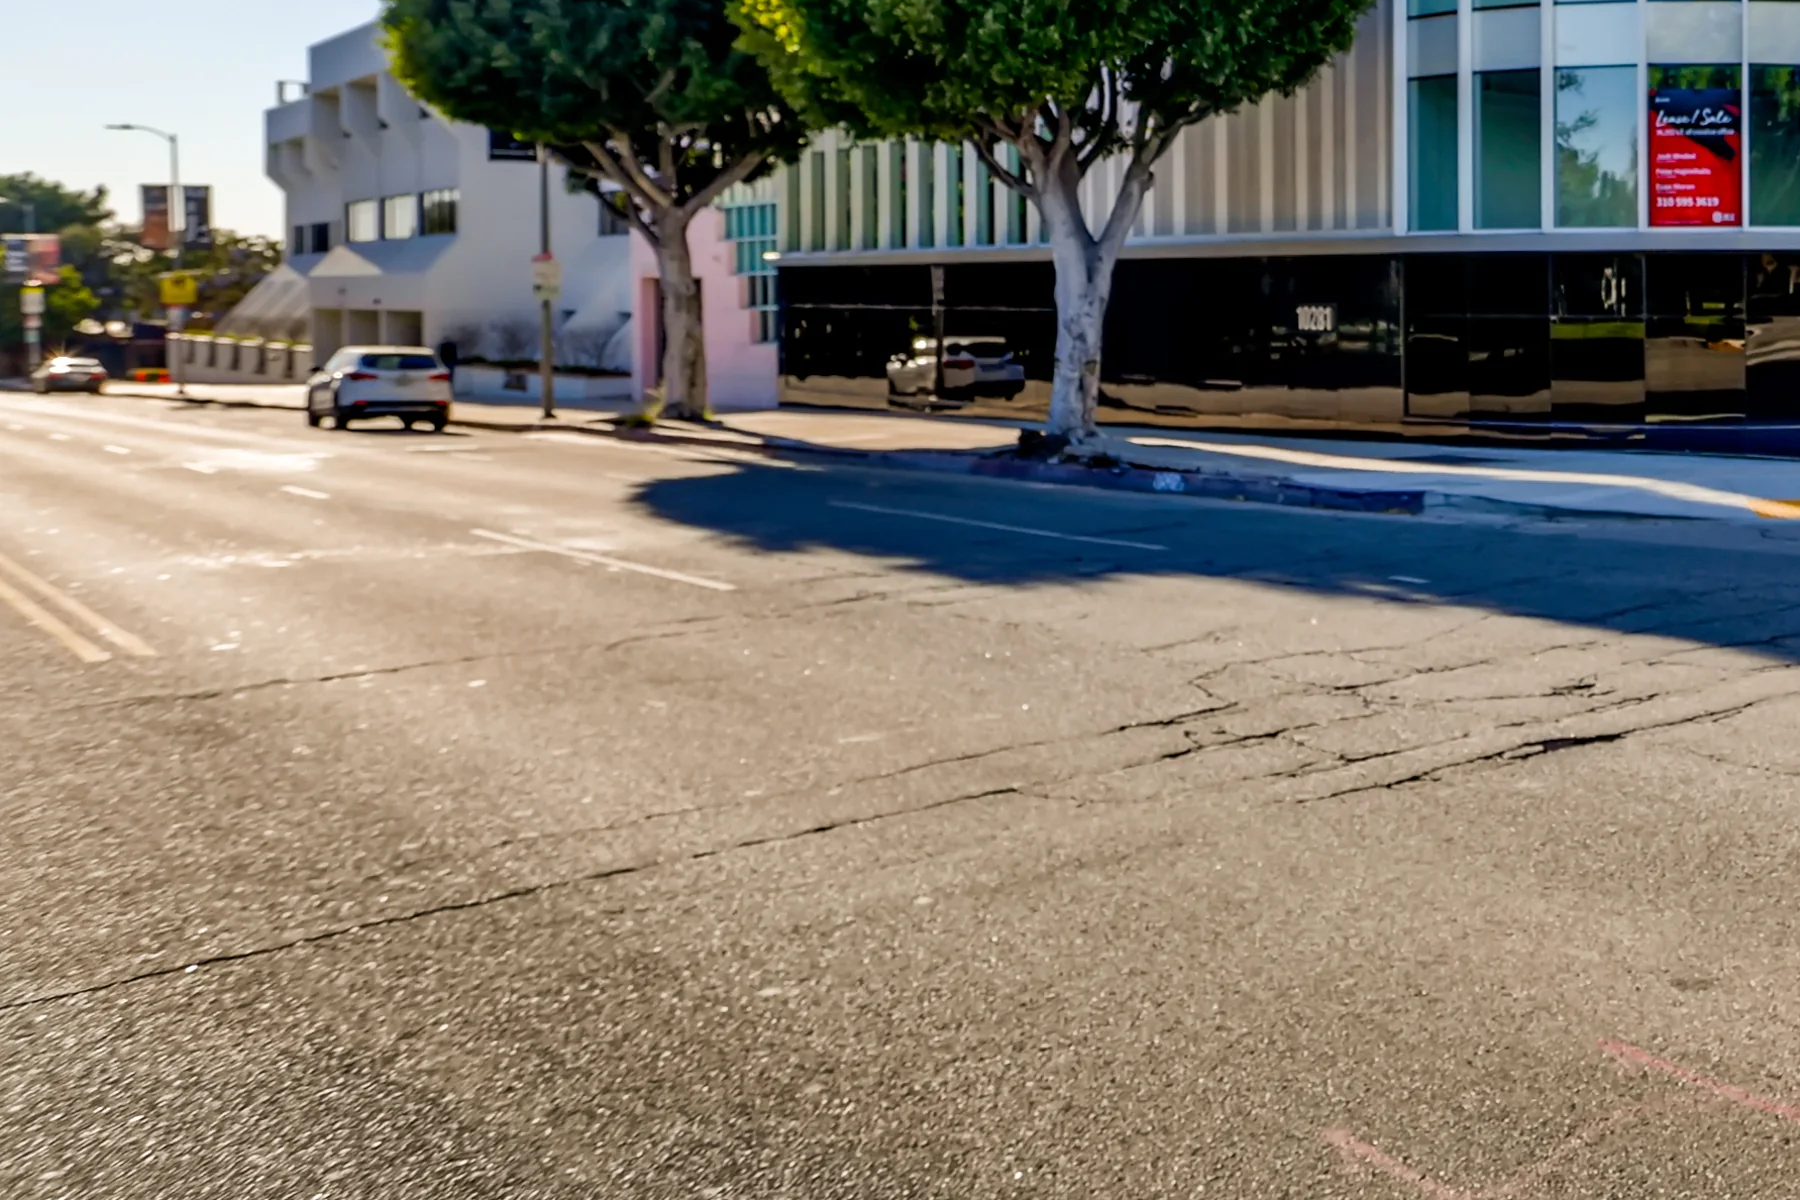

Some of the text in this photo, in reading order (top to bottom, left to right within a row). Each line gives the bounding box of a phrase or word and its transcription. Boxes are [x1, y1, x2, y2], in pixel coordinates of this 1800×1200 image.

[1655, 109, 1690, 127] Lease
[1700, 107, 1732, 126] Sale
[1656, 196, 1674, 207] 310
